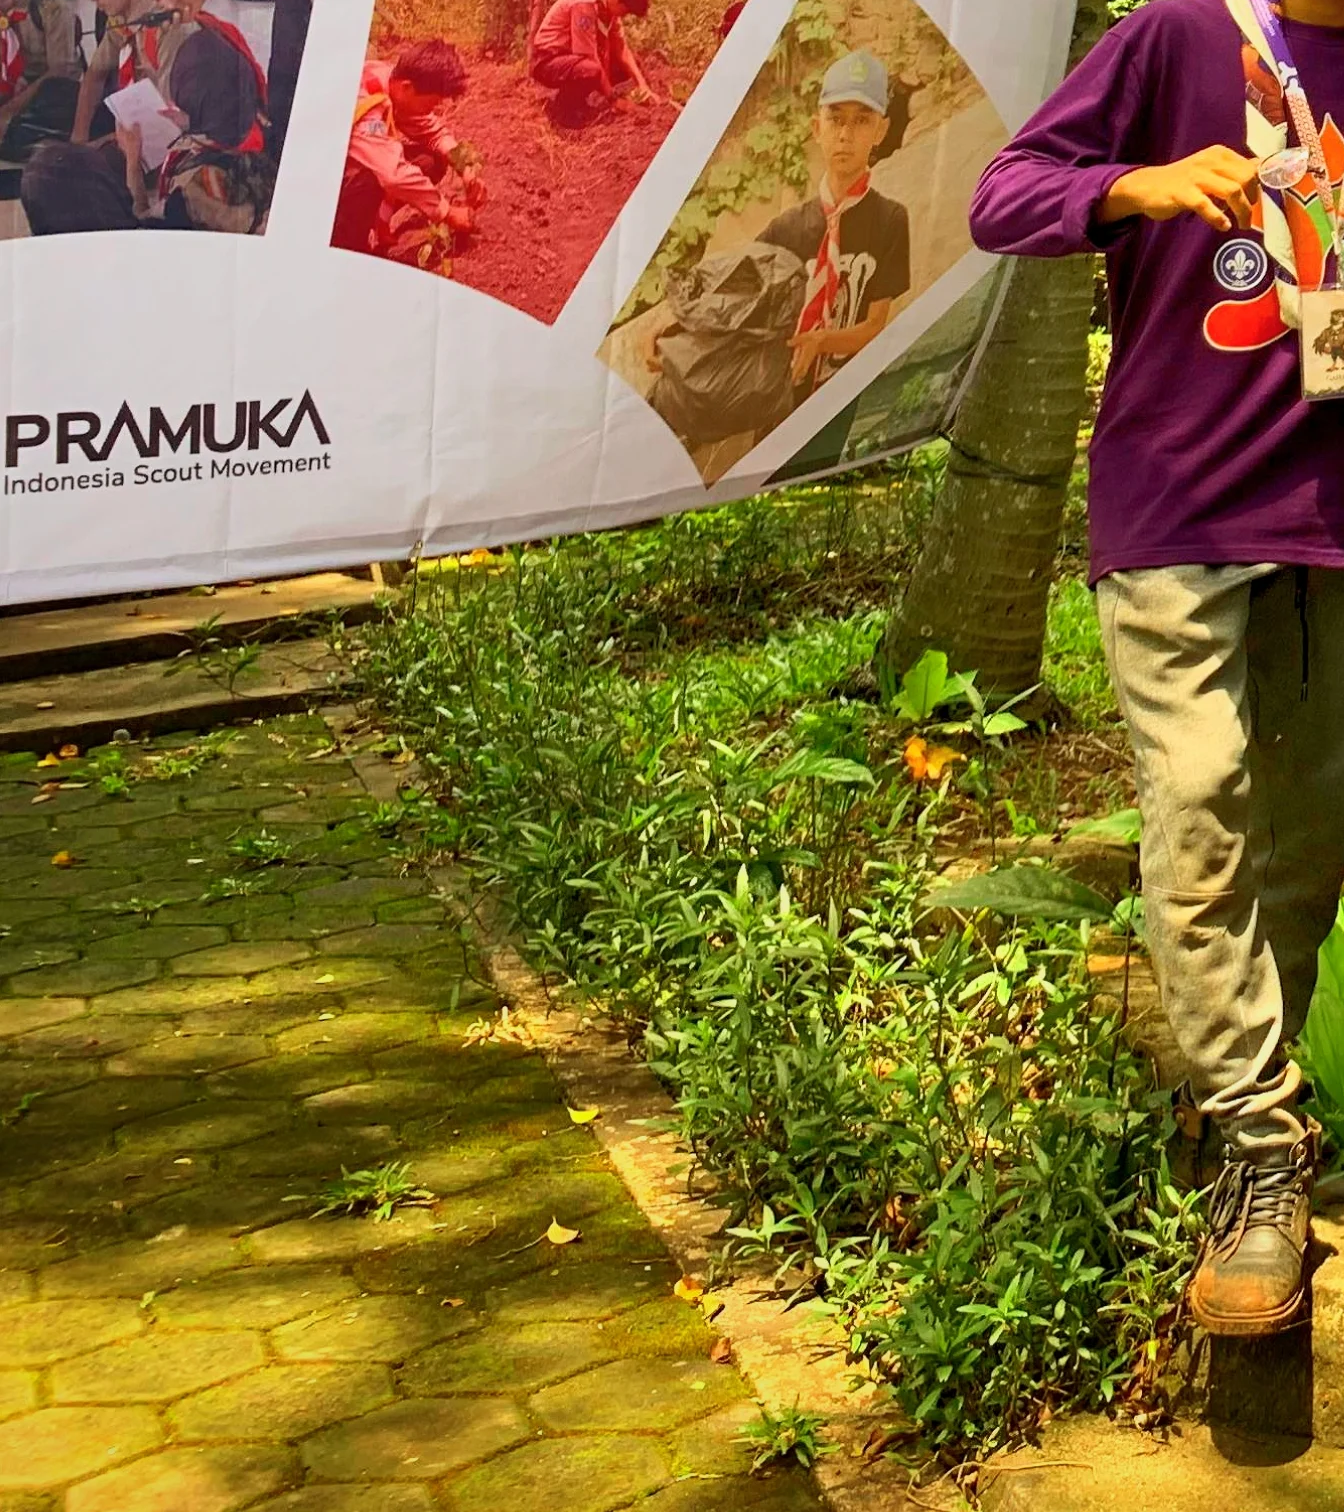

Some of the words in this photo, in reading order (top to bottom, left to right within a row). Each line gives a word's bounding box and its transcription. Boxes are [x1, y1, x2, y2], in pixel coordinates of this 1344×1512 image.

[5, 388, 331, 468] PRAMUKA
[4, 468, 125, 495] Indonesia
[133, 462, 203, 486] Scout
[210, 451, 331, 480] Movement
